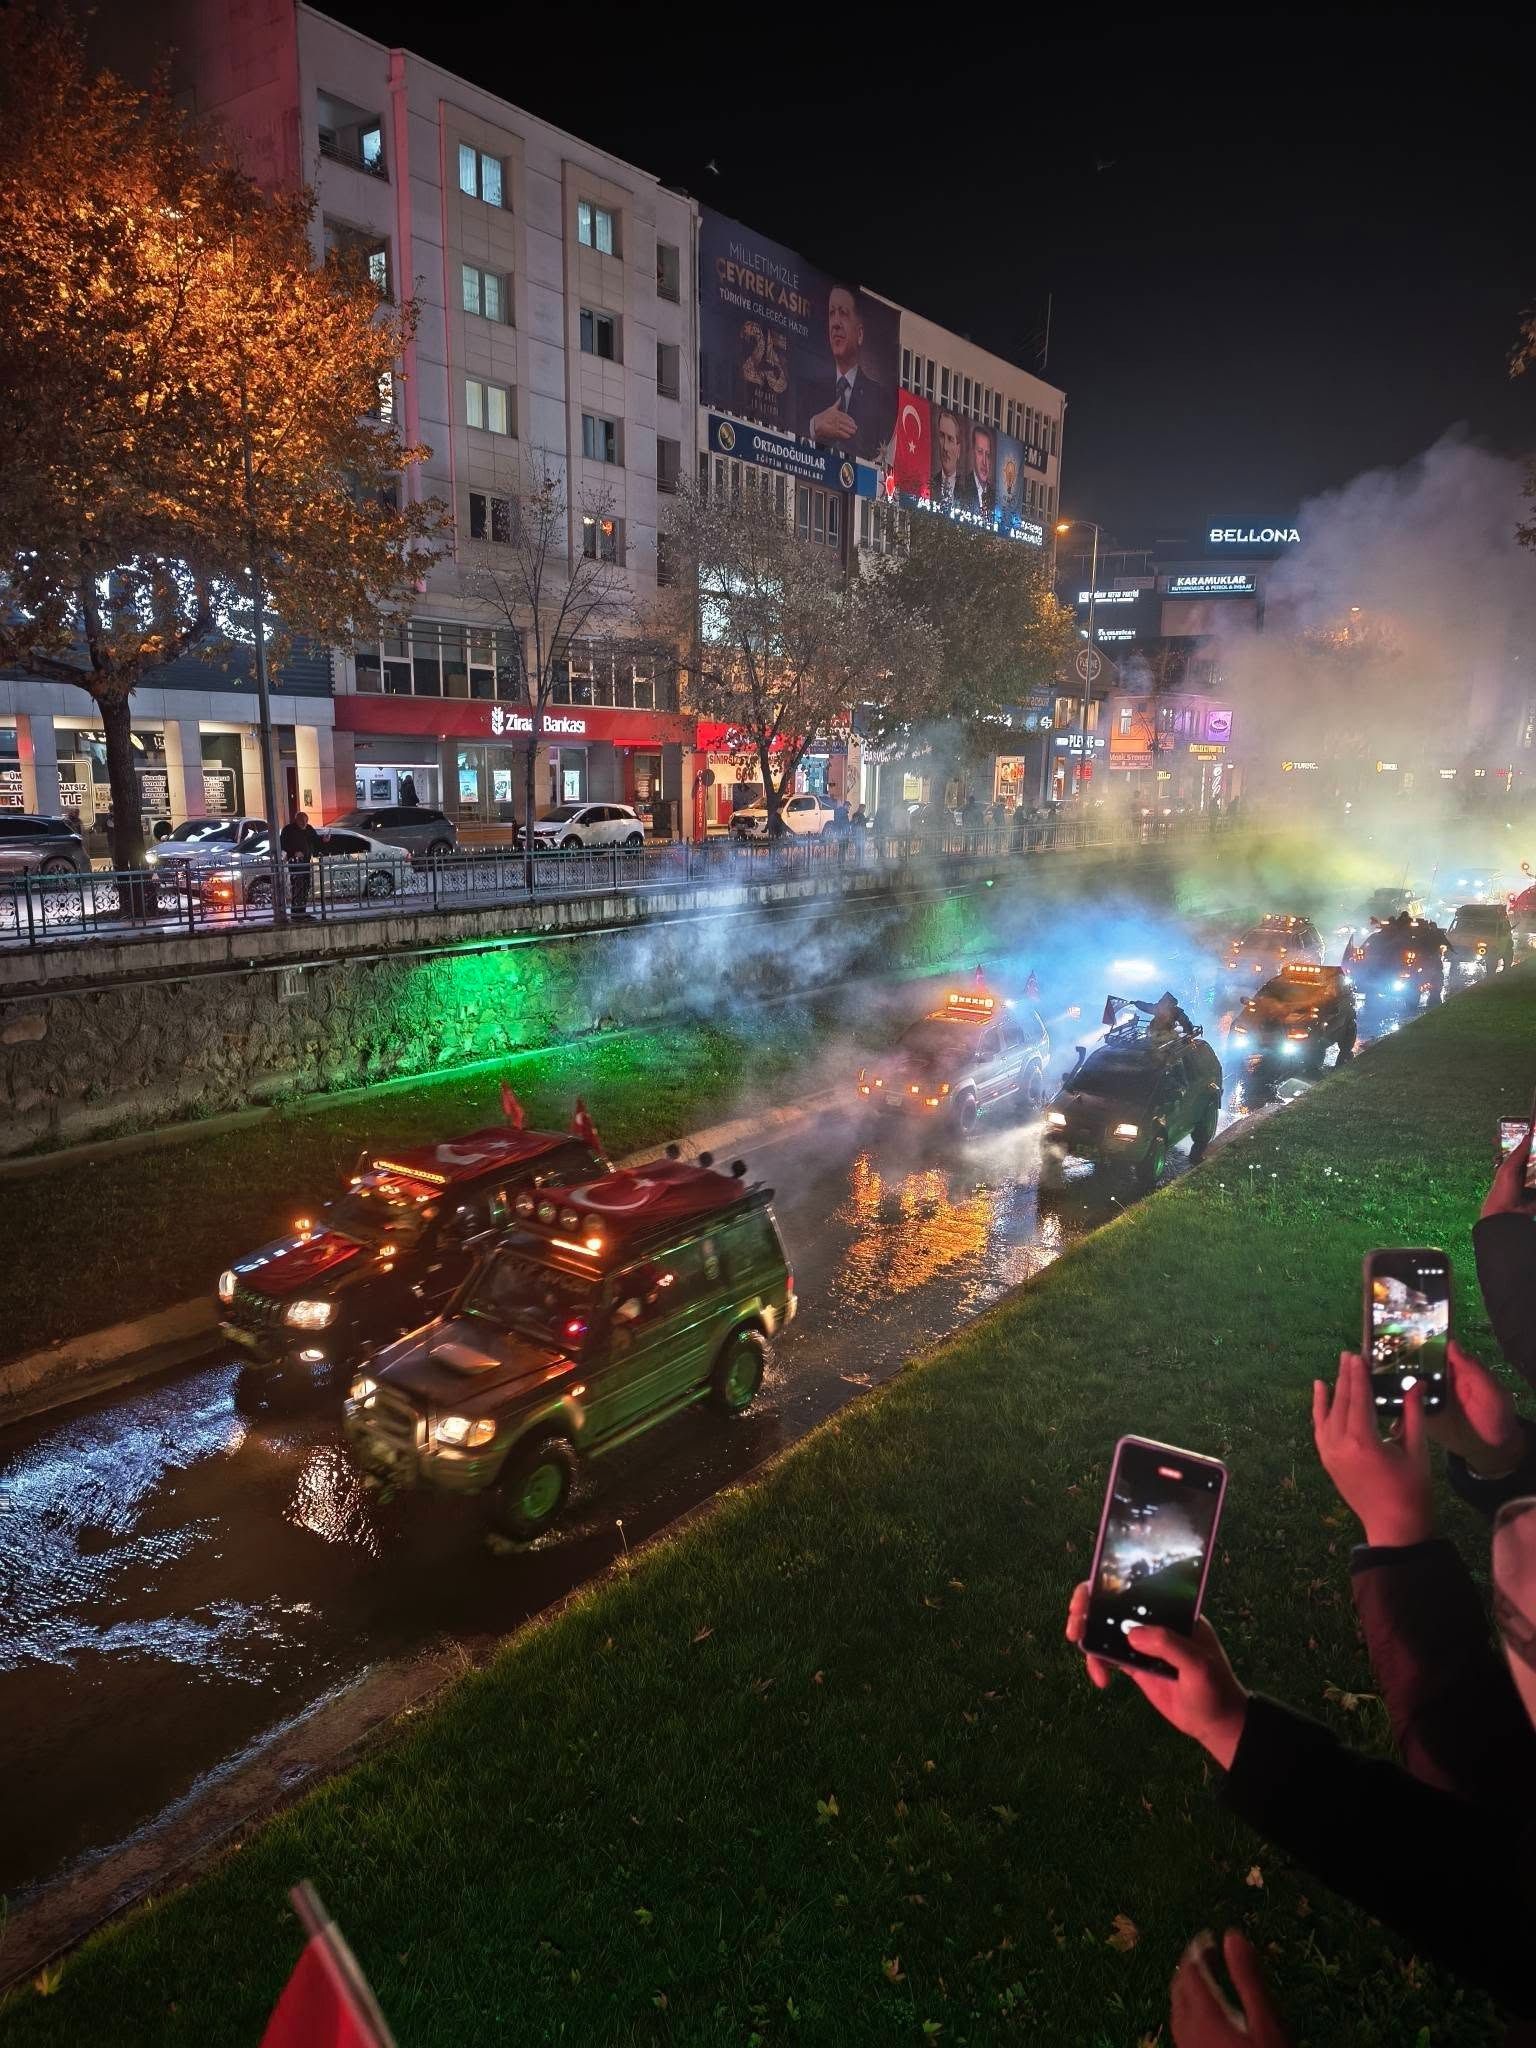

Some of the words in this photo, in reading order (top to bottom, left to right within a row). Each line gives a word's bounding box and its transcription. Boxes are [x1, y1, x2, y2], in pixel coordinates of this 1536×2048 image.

[715, 256, 774, 302] ÇEYREK
[719, 287, 752, 312] TÜRKİYE
[753, 435, 826, 471] ORTADOĞULULAR
[756, 453, 782, 468] EĞİTİM
[1209, 528, 1300, 542] BELLONA
[1177, 575, 1247, 586] KARAMUKLAR
[543, 715, 586, 734] Bankası
